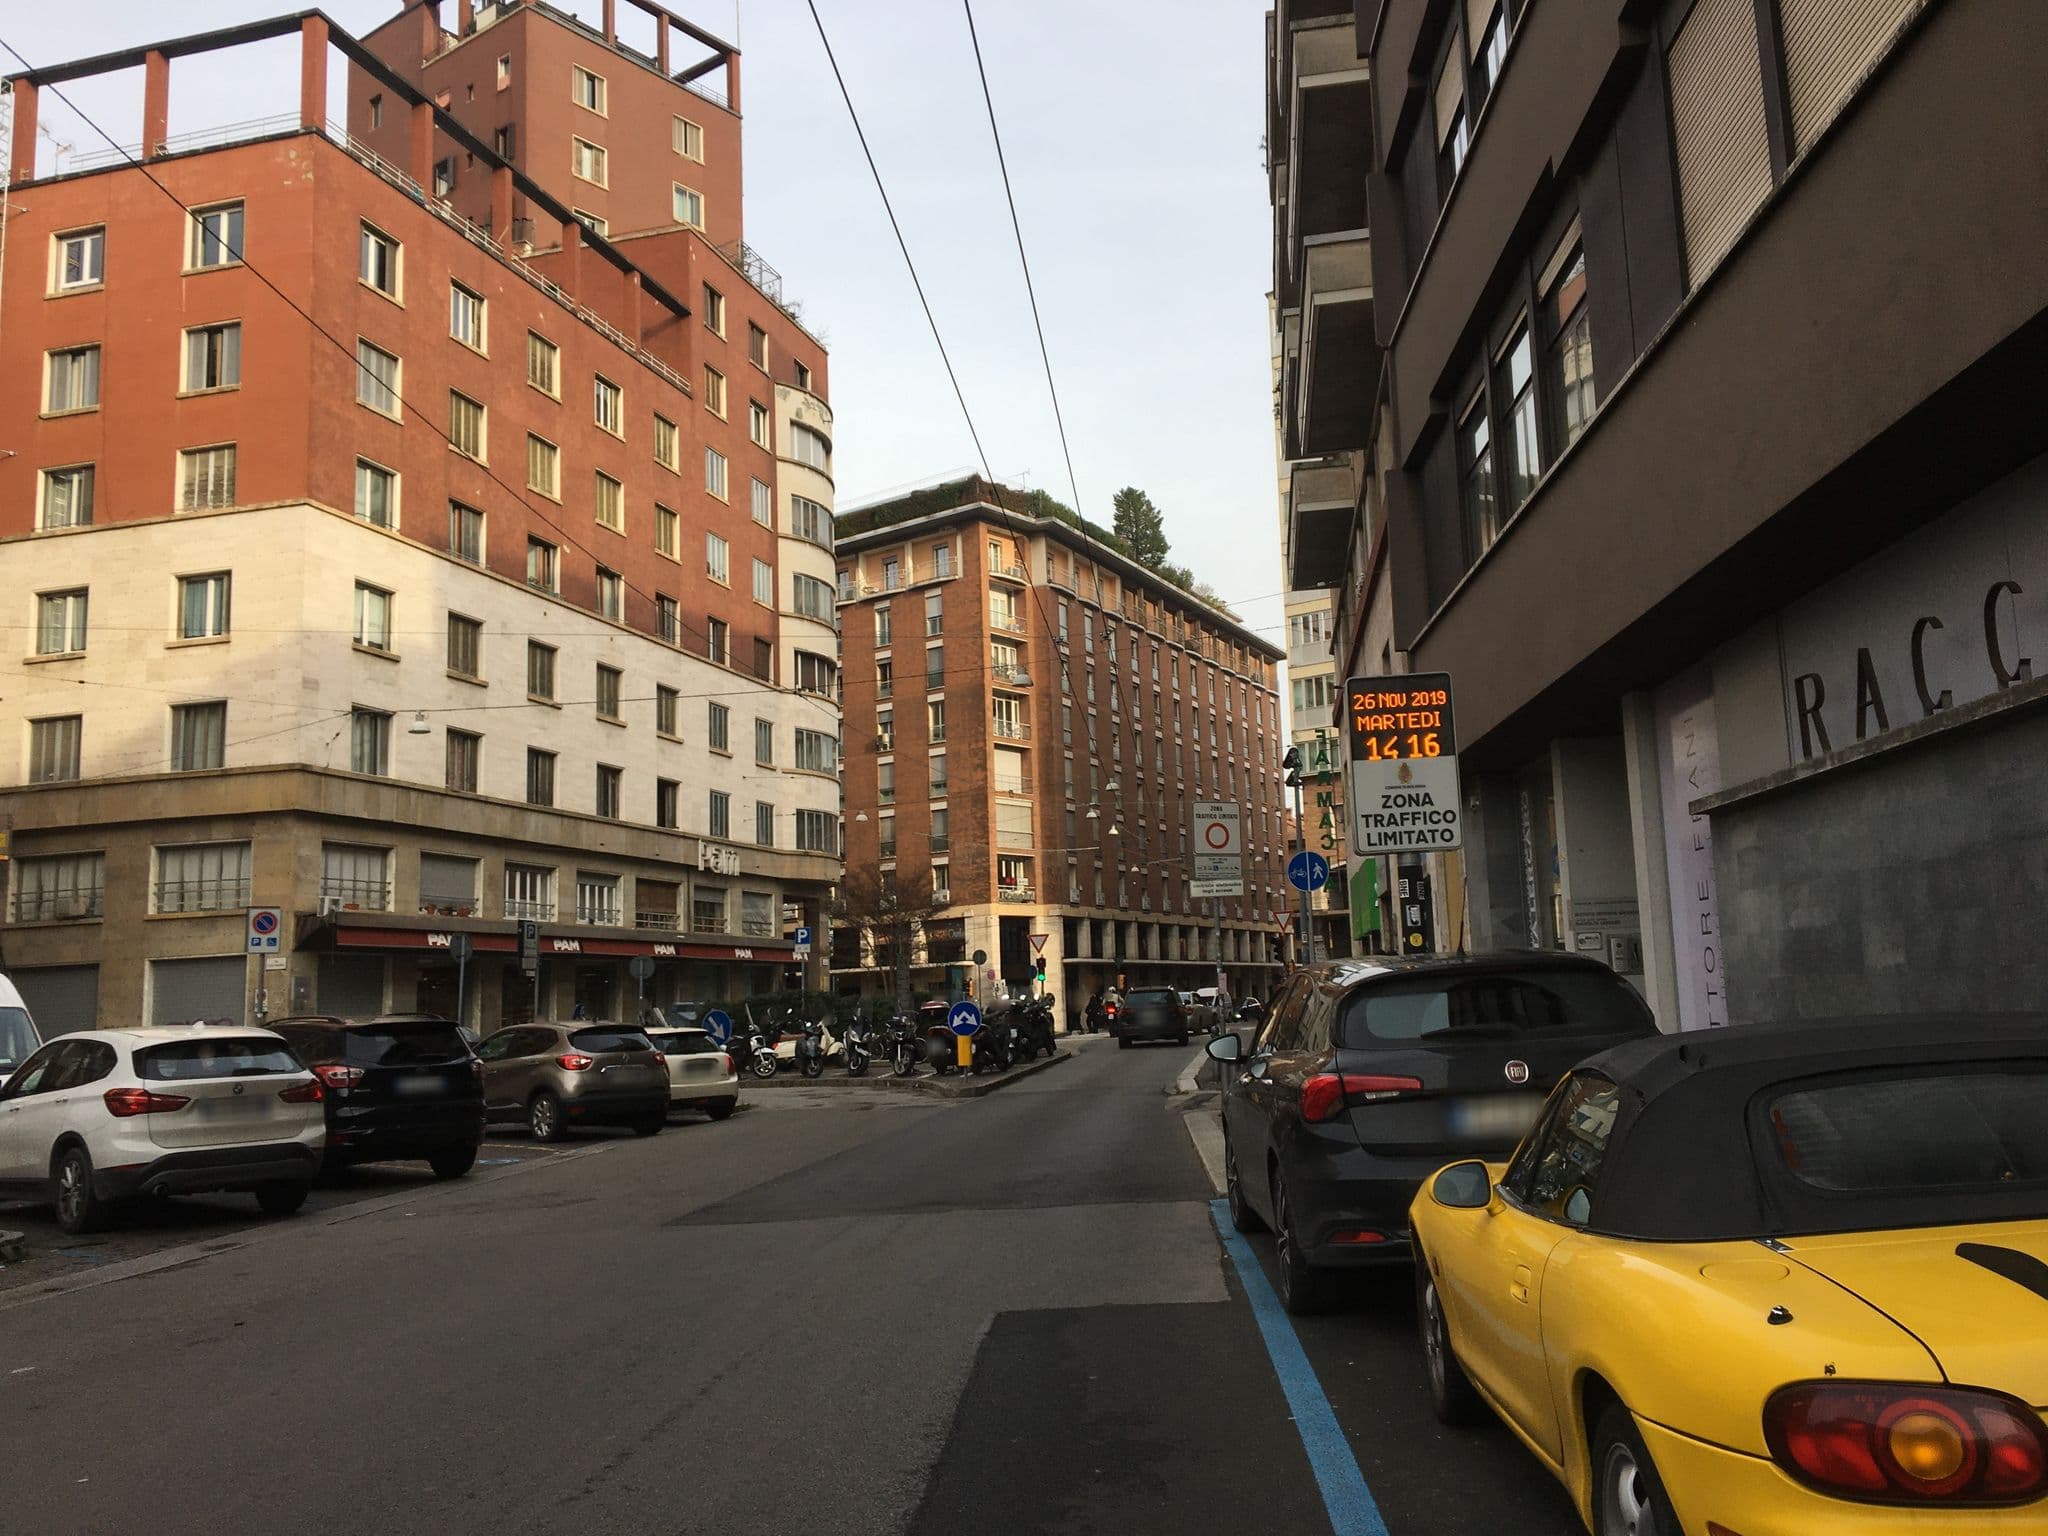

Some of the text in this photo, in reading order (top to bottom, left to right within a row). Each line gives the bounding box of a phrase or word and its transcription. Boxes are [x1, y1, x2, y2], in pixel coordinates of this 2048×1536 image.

[1794, 581, 2031, 760] RACC
[1353, 690, 1447, 710] 26 NOV 2019
[1357, 711, 1441, 731] MARTEDI
[1683, 718, 1704, 851] FANI
[1382, 792, 1434, 809] ZONA
[1361, 809, 1457, 829] TRAFFICO
[1367, 828, 1454, 847] LIMITATO
[698, 840, 741, 877] Pam
[428, 934, 452, 946] PA
[553, 939, 580, 951] PAM
[797, 929, 808, 943] P
[653, 944, 676, 955] PAM
[735, 948, 753, 959] PAM
